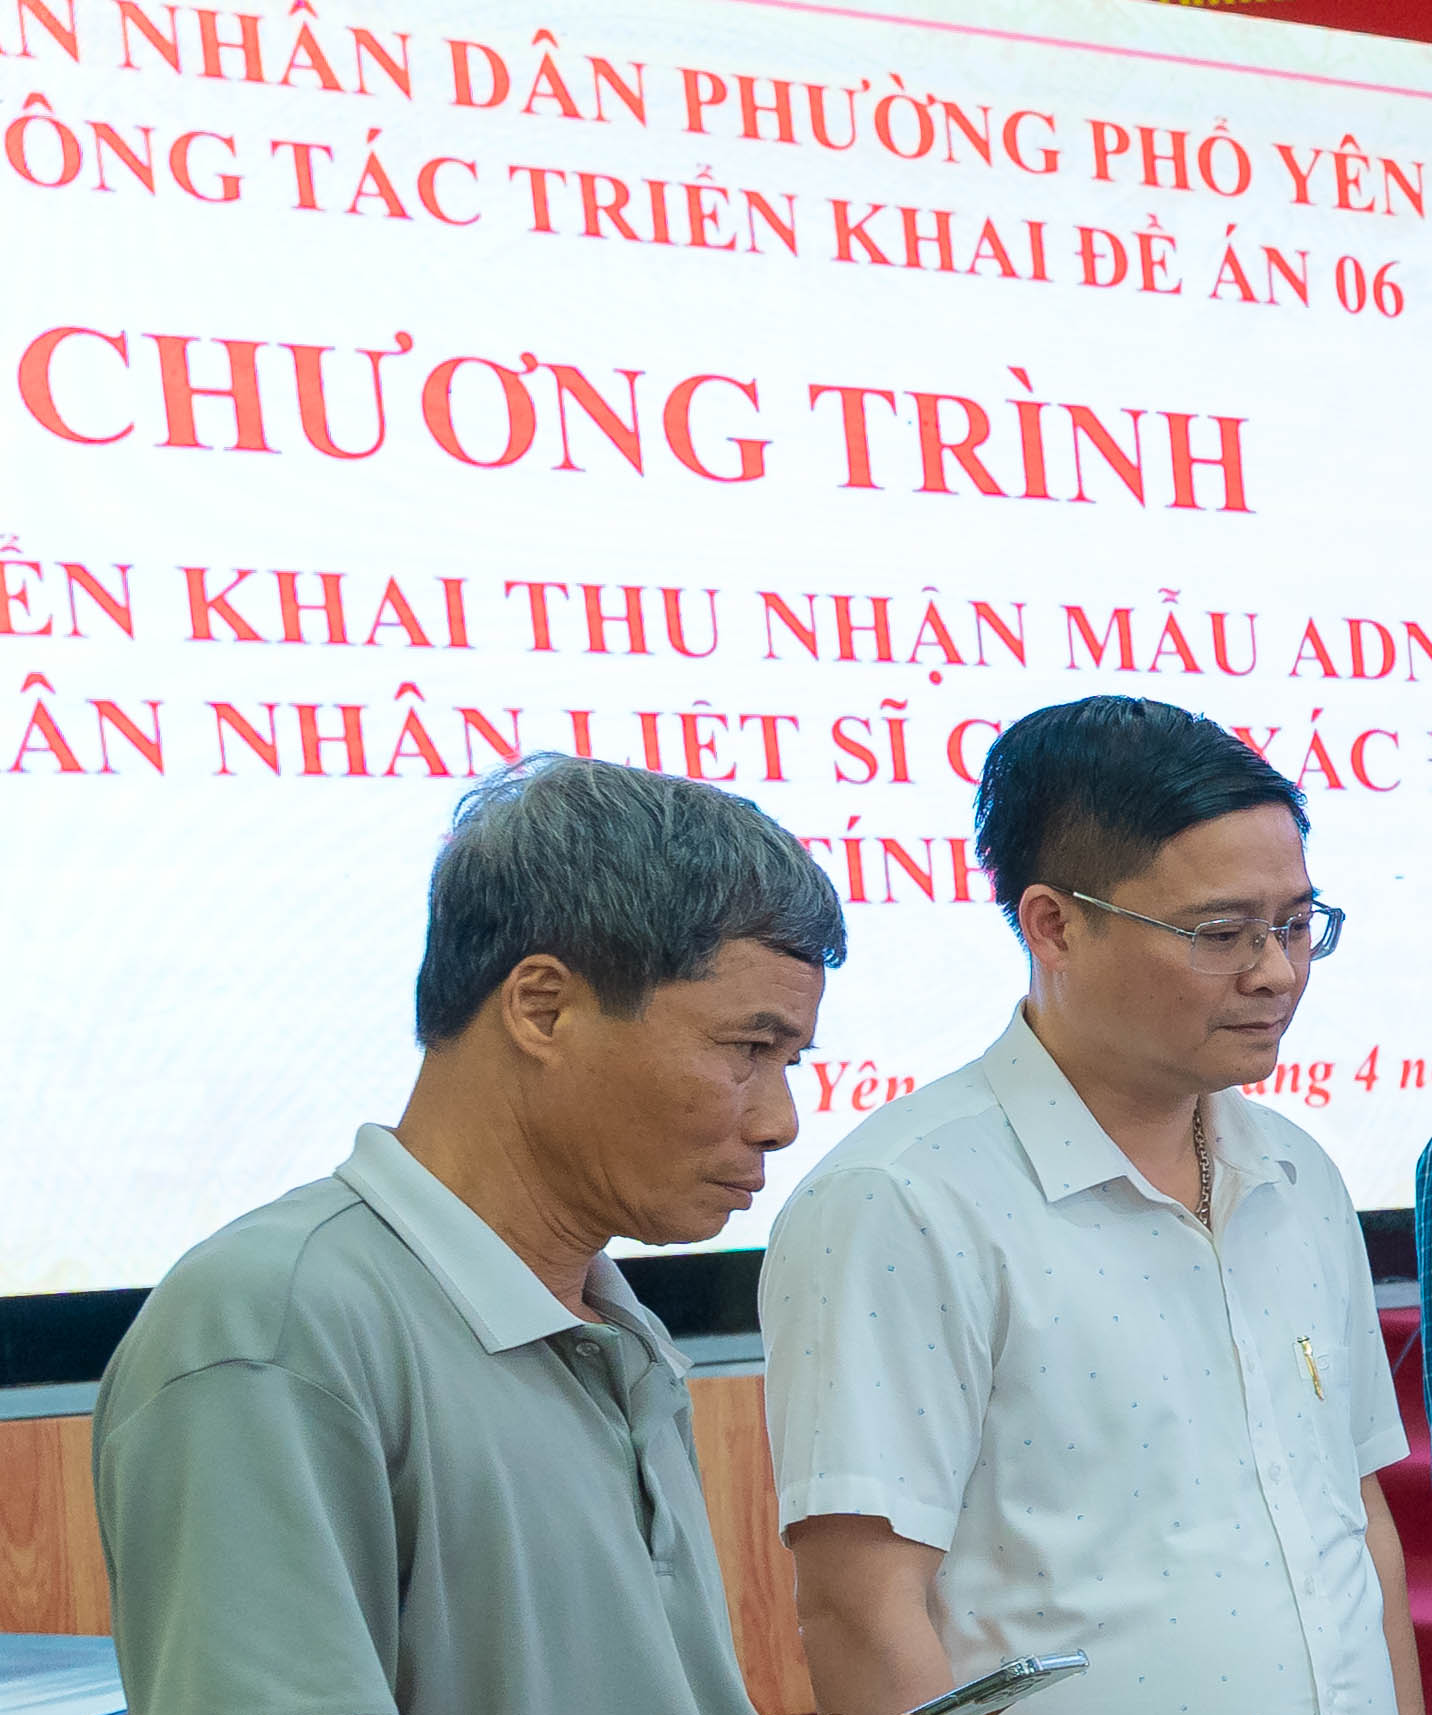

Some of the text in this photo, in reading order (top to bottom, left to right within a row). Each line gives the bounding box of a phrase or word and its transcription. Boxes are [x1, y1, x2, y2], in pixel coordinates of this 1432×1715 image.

[115, 0, 413, 99] NHÂN
[447, 28, 647, 126] DÂN
[679, 68, 1061, 175] PHƯỜNG
[1086, 116, 1252, 198] PHỔ
[1273, 133, 1426, 218] YÊN
[4, 92, 1405, 320] ÔNG TÁC TRIỂN KHAI ĐỀ ÁN 06
[16, 325, 1256, 515] CHƯƠNG TRÌNH
[177, 566, 473, 650] KHAI
[503, 580, 722, 660] THU
[757, 585, 1028, 687] NHẬN
[1062, 587, 1258, 679] MẪU
[8, 671, 166, 777] ÂN
[205, 681, 524, 779] NHÂN
[830, 697, 916, 786] SĨ
[797, 815, 998, 905] ÍNH
[1353, 1045, 1380, 1093] 4
